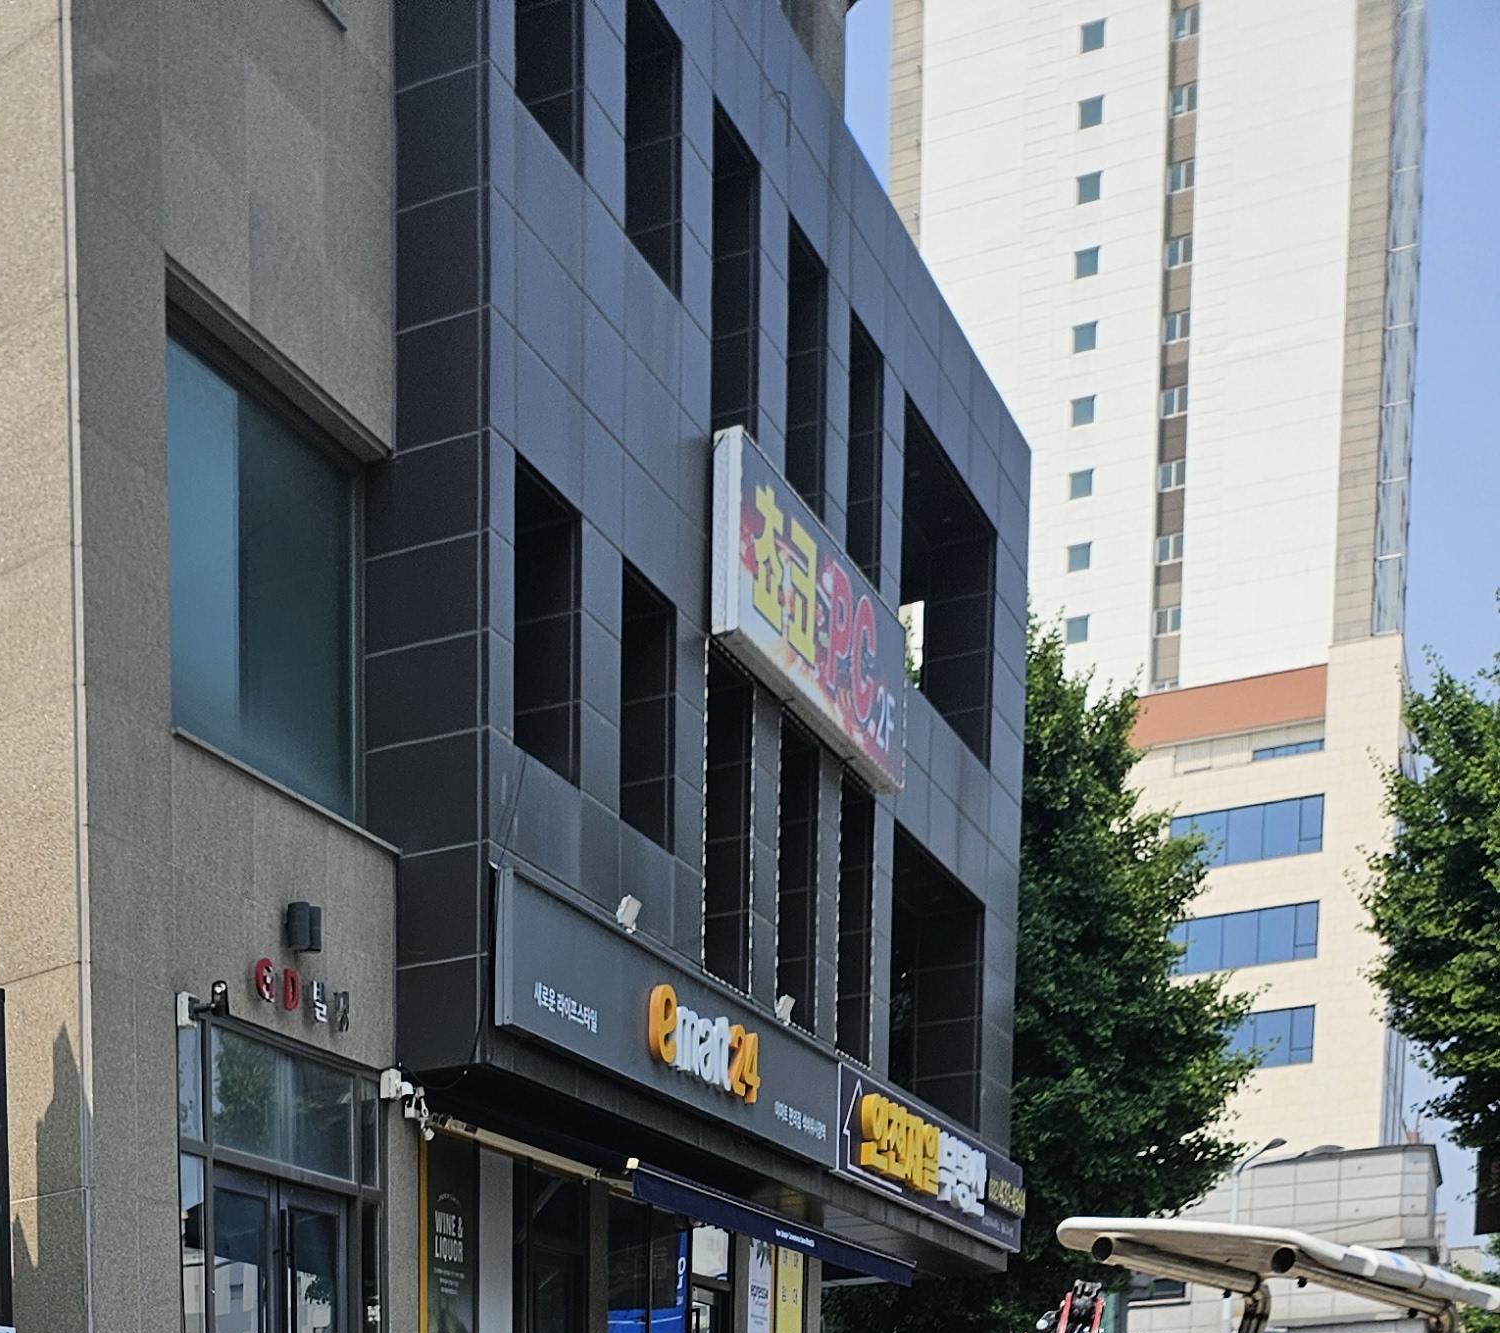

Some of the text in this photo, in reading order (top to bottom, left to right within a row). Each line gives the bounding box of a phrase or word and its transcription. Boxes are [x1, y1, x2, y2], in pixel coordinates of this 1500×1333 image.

[877, 687, 896, 753] 2F
[533, 981, 598, 1034] 새로운 라이프스타일
[649, 984, 761, 1104] emart24
[434, 1210, 464, 1239] WINE &
[434, 1235, 464, 1263] LIQUOR
